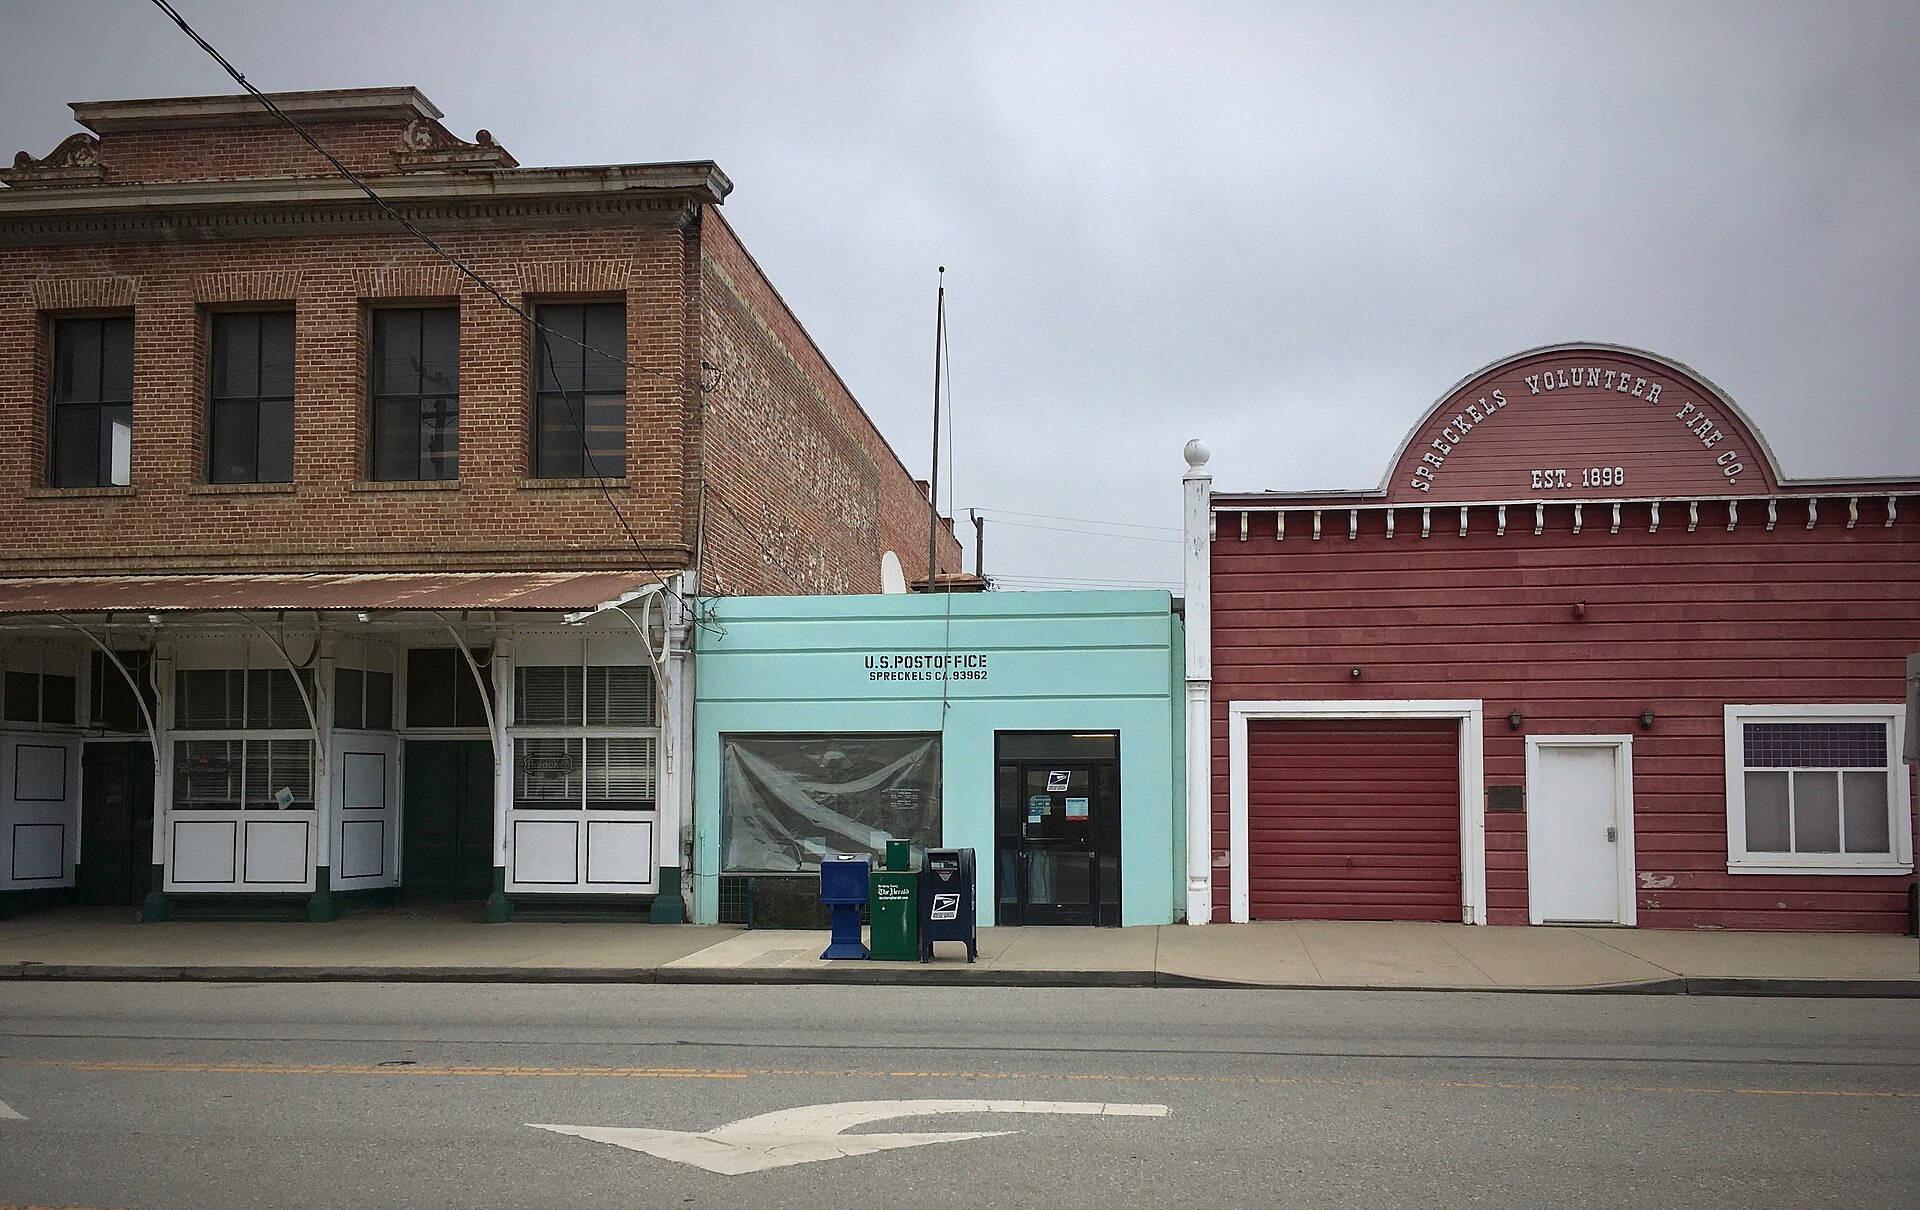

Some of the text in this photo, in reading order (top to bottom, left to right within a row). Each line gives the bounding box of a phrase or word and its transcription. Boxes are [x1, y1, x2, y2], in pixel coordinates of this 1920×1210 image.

[1411, 367, 1744, 492] SPRECKELS VOLUNTEER FIRE CO.
[1531, 466, 1624, 489] EST. 1898
[869, 671, 932, 680] SPRECKELS
